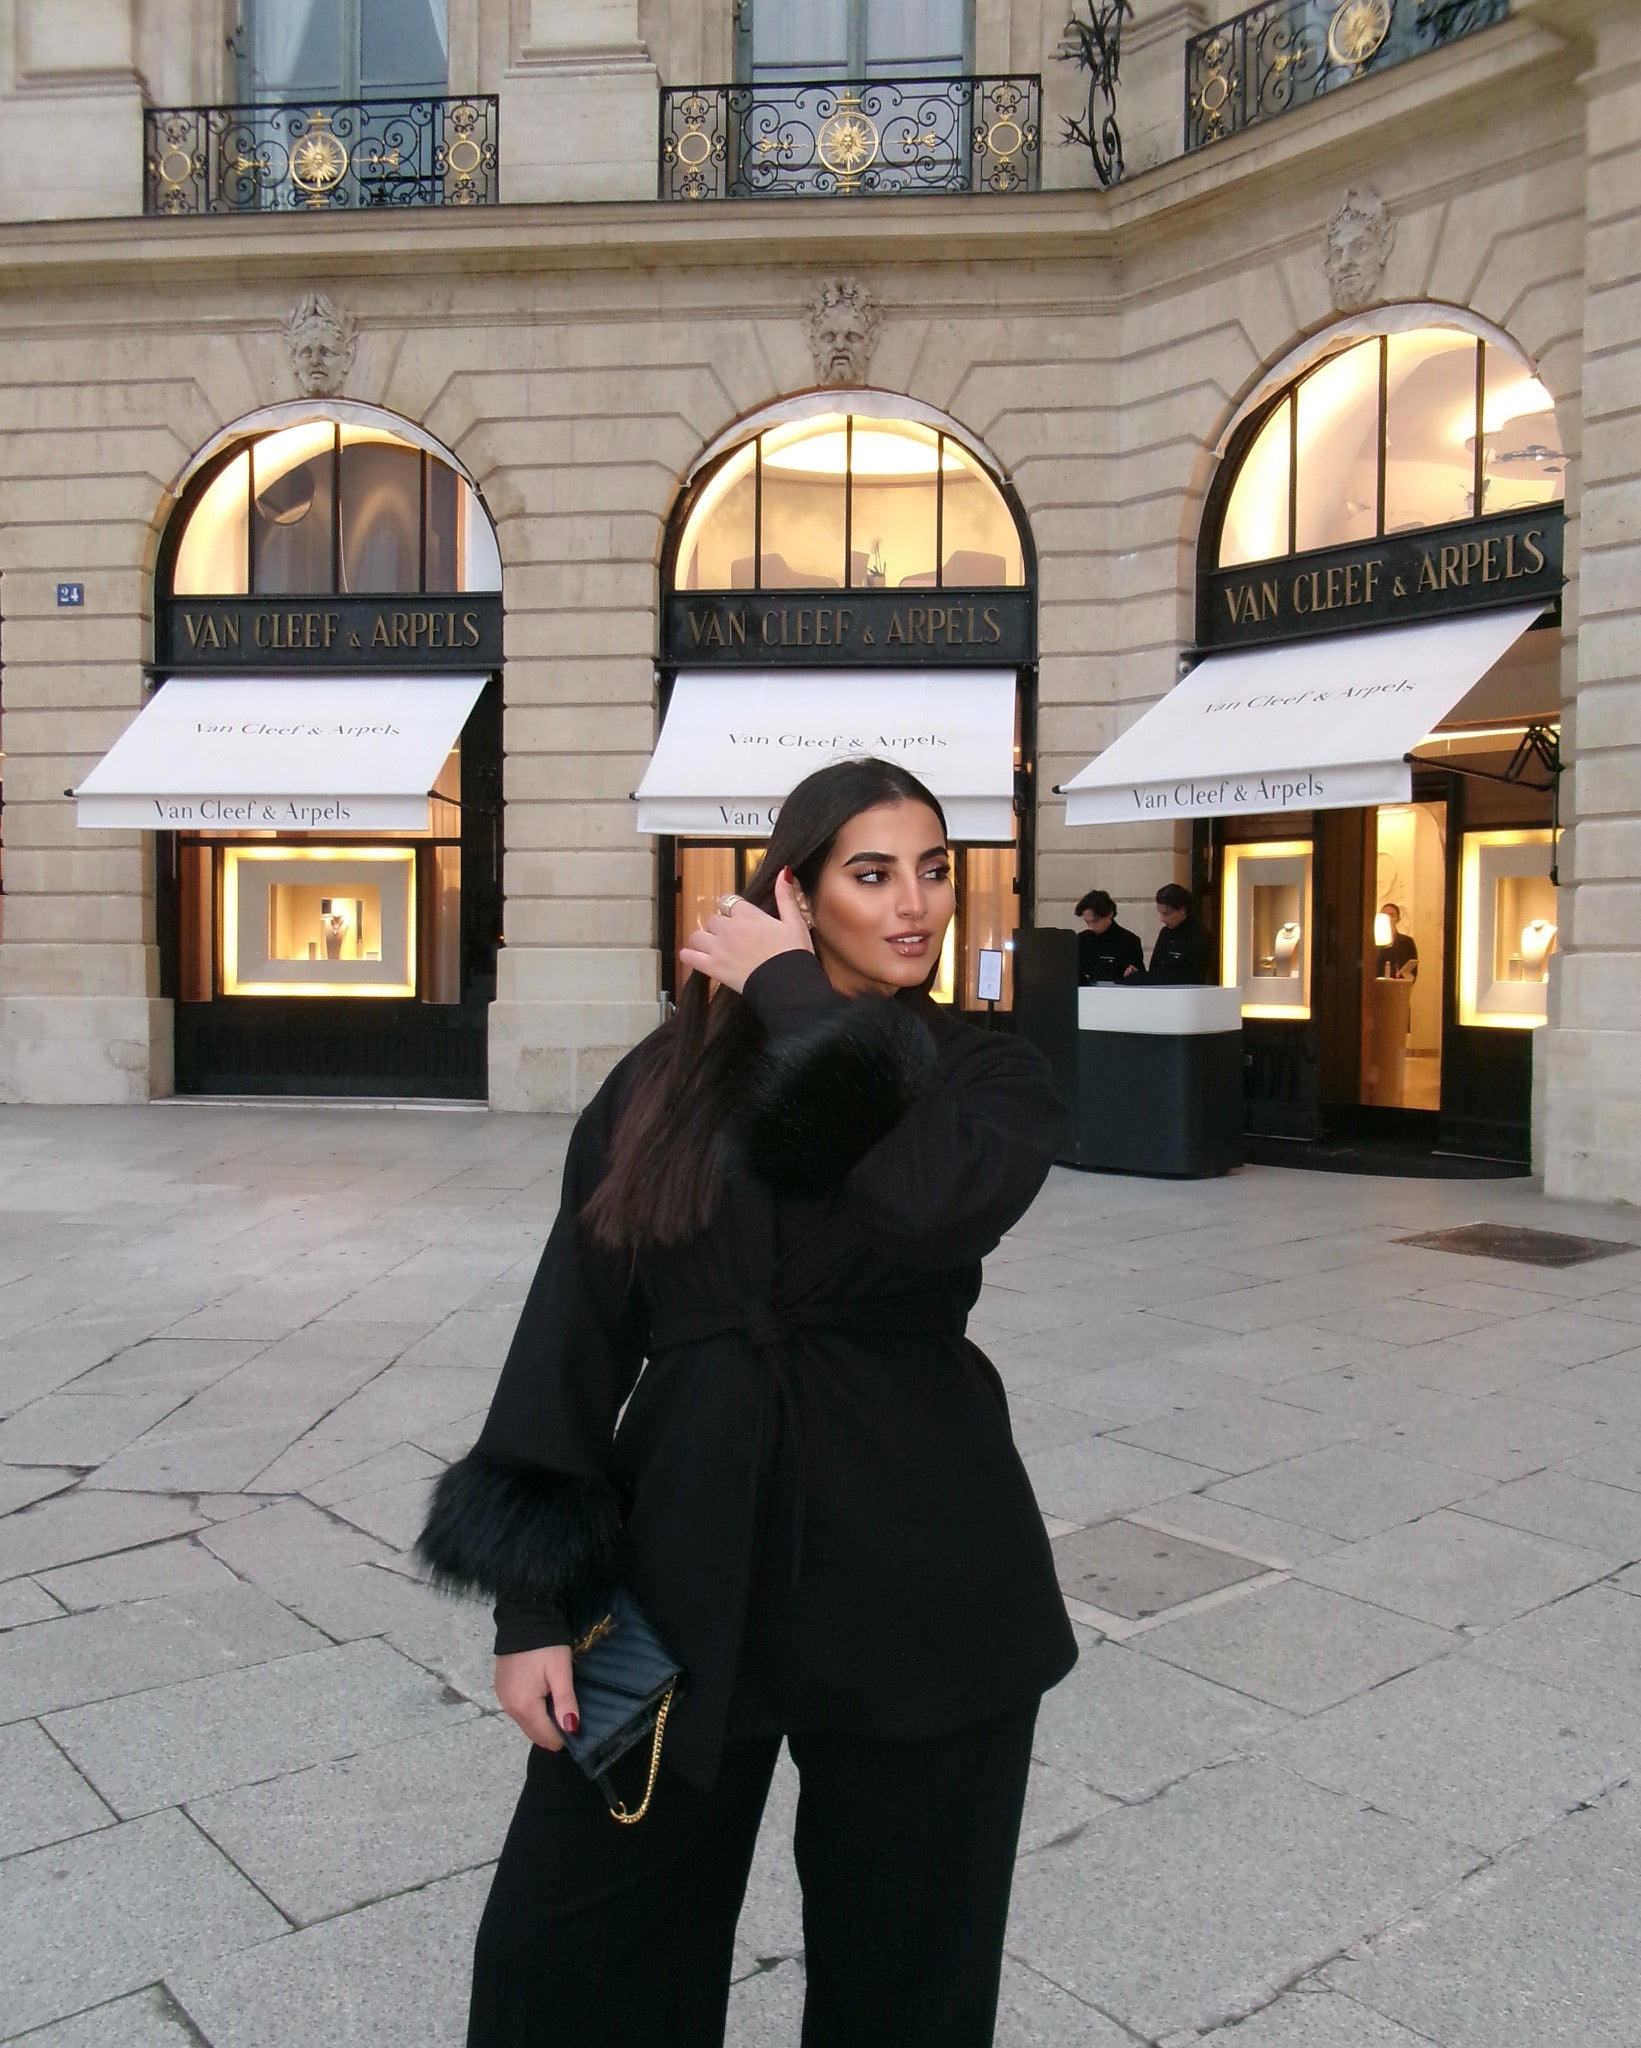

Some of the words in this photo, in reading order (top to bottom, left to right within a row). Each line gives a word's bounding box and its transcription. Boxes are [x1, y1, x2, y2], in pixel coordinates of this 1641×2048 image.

[1224, 579, 1278, 624] VAN
[1293, 560, 1383, 614] CLEEF
[1393, 576, 1407, 597] &
[1417, 530, 1546, 594] ARPELS
[60, 587, 79, 602] 24
[184, 613, 241, 648] VAN
[254, 613, 340, 648] CLEEF
[349, 630, 362, 648] &
[370, 612, 480, 648] ARPELS
[687, 610, 747, 647] VAN
[761, 609, 852, 647] CLEEF
[863, 626, 876, 645] &
[886, 607, 1001, 645] ARPELS
[1247, 691, 1314, 709] Cleef
[1313, 692, 1329, 702] &
[1340, 679, 1416, 699] Arpels
[197, 723, 234, 734] Van
[241, 723, 304, 736] Cleef
[307, 726, 322, 735] &
[328, 724, 401, 737] Arpels
[728, 733, 769, 745] Van
[778, 734, 842, 748] Cleef
[849, 736, 864, 747] &
[872, 734, 947, 749] Arpels
[1133, 787, 1167, 809] Van
[1174, 780, 1229, 806] Cleef
[1234, 784, 1248, 802] &
[1254, 774, 1324, 806] Arpels
[154, 800, 193, 819] Van
[199, 799, 256, 820] Cleef
[261, 805, 277, 820] &
[283, 801, 351, 826] Arpels
[719, 805, 759, 826] Van
